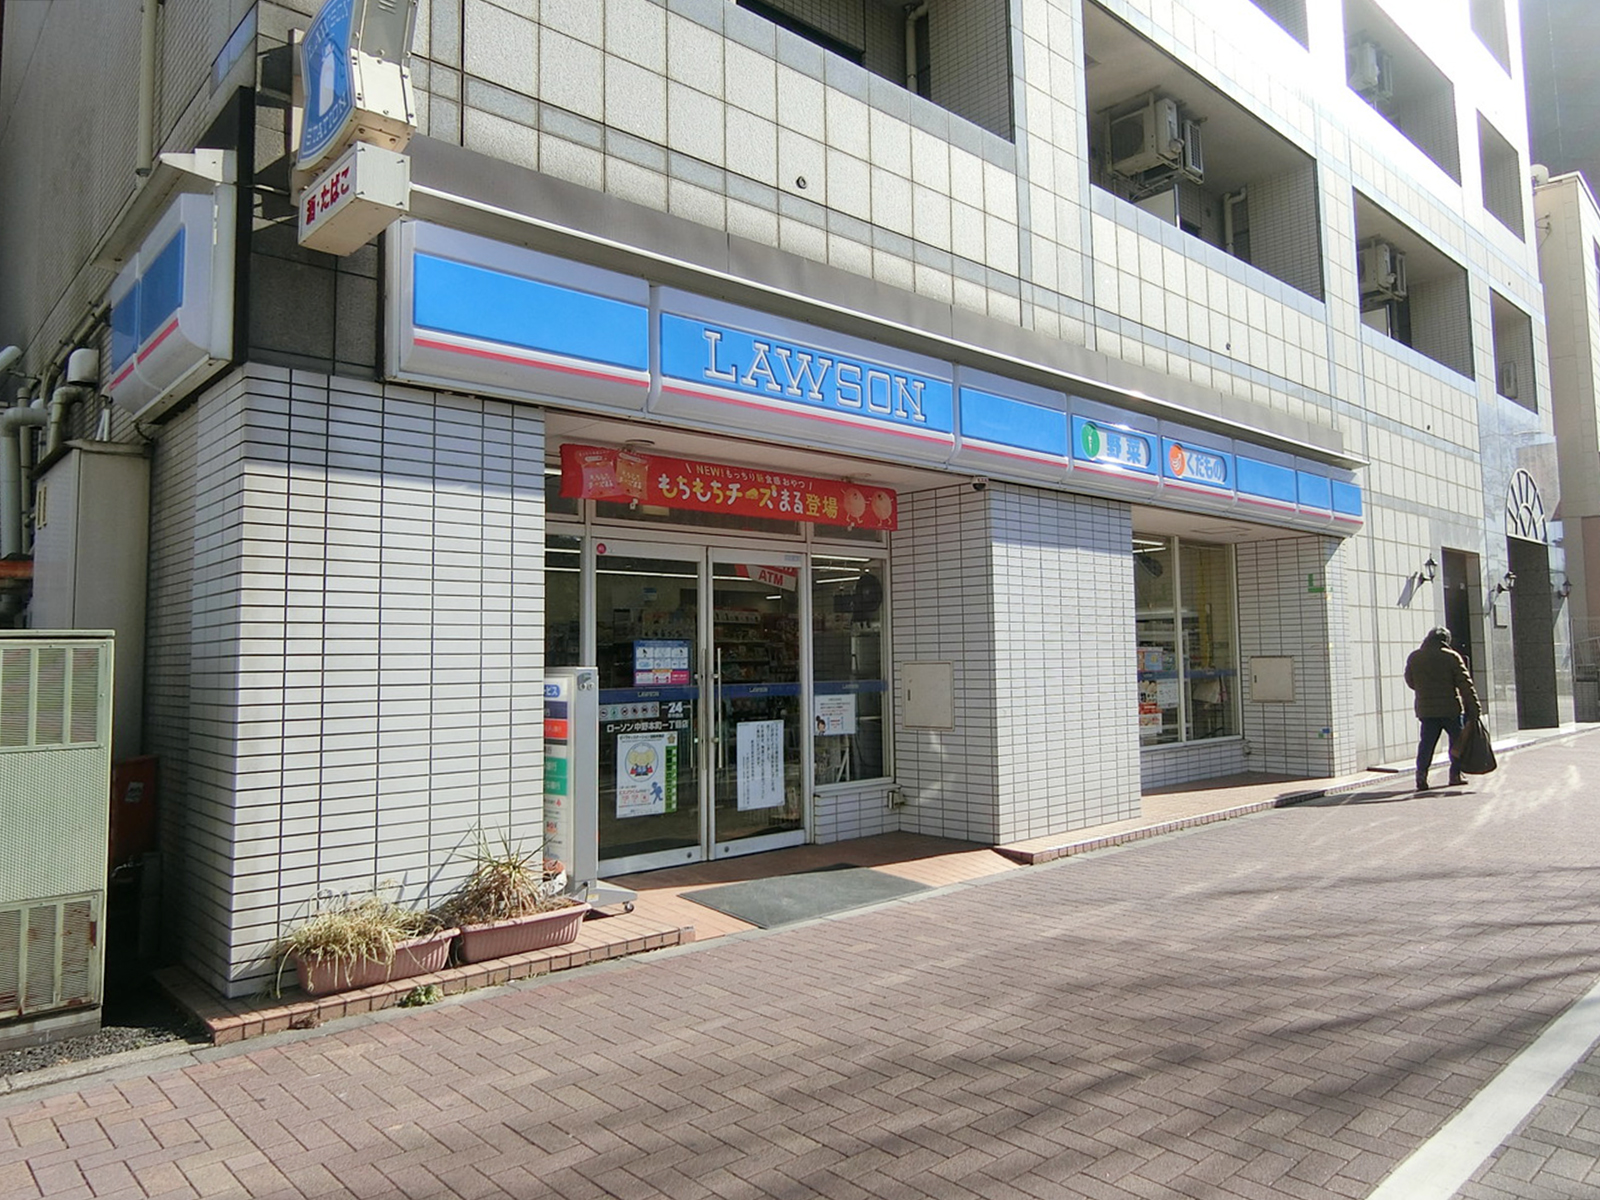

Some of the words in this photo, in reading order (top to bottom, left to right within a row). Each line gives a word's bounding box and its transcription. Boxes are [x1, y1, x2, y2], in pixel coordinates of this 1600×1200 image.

[305, 91, 347, 146] STATION
[704, 329, 926, 422] LAWSON
[1106, 432, 1141, 464] 野菜
[696, 464, 724, 478] NEW!
[1187, 451, 1223, 480] くだもの
[759, 569, 783, 586] ATM
[668, 701, 684, 713] 24
